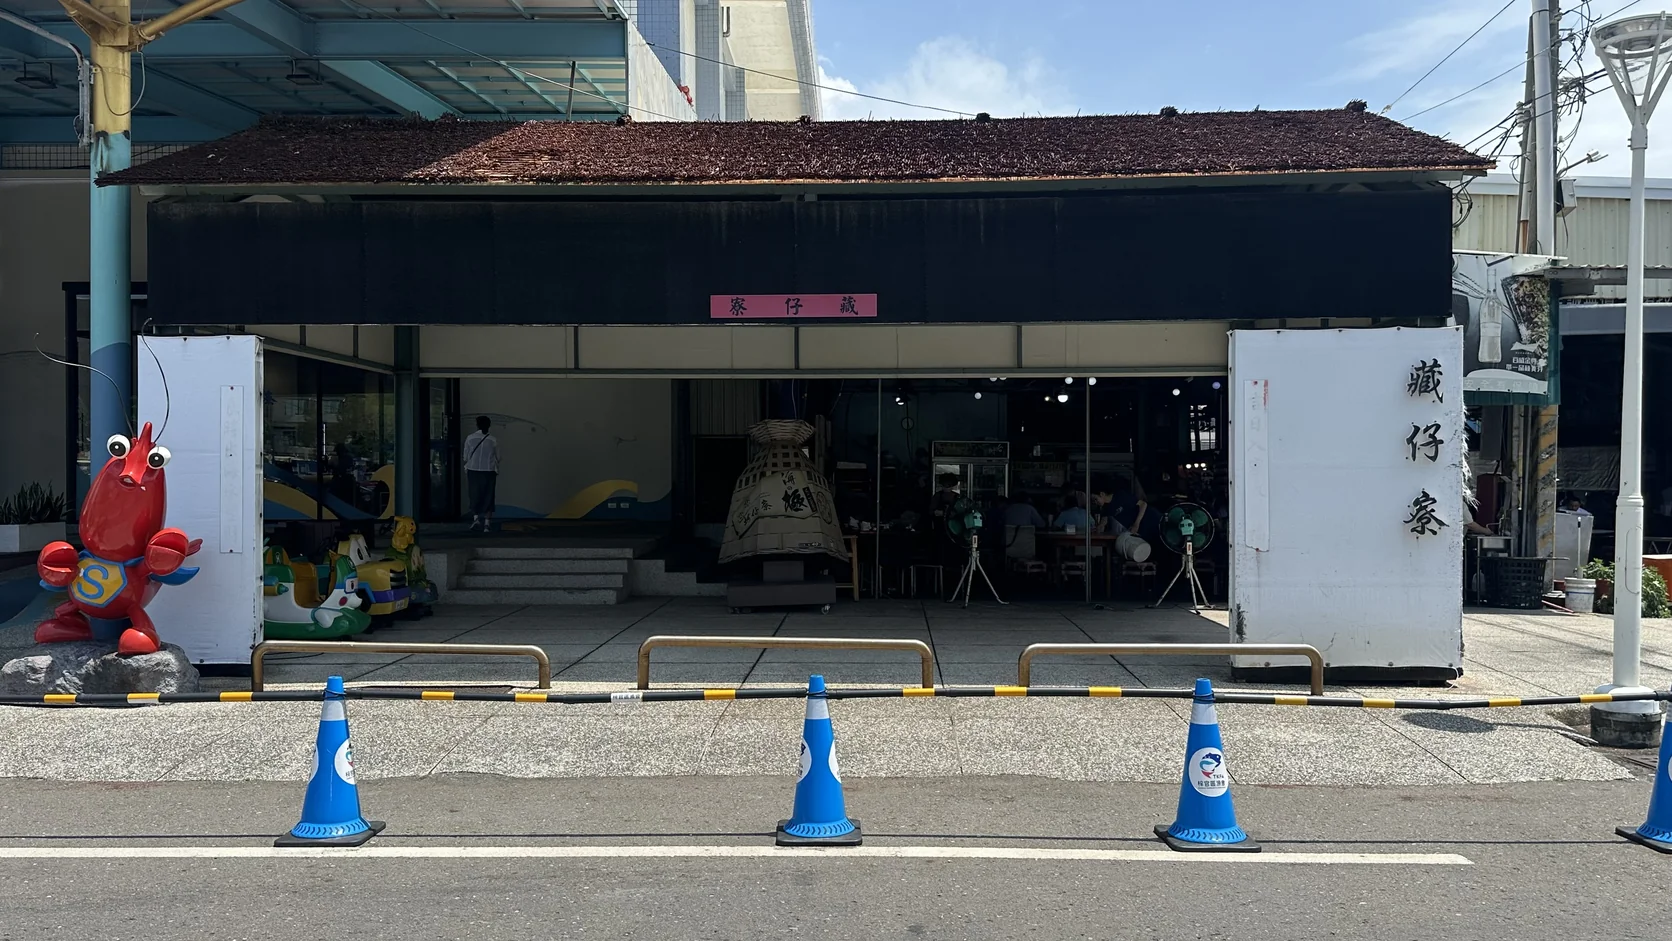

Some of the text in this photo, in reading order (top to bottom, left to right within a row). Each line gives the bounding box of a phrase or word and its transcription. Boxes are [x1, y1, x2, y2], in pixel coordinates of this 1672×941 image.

[1403, 358, 1450, 536] 藏仔寮
[77, 564, 109, 599] S
